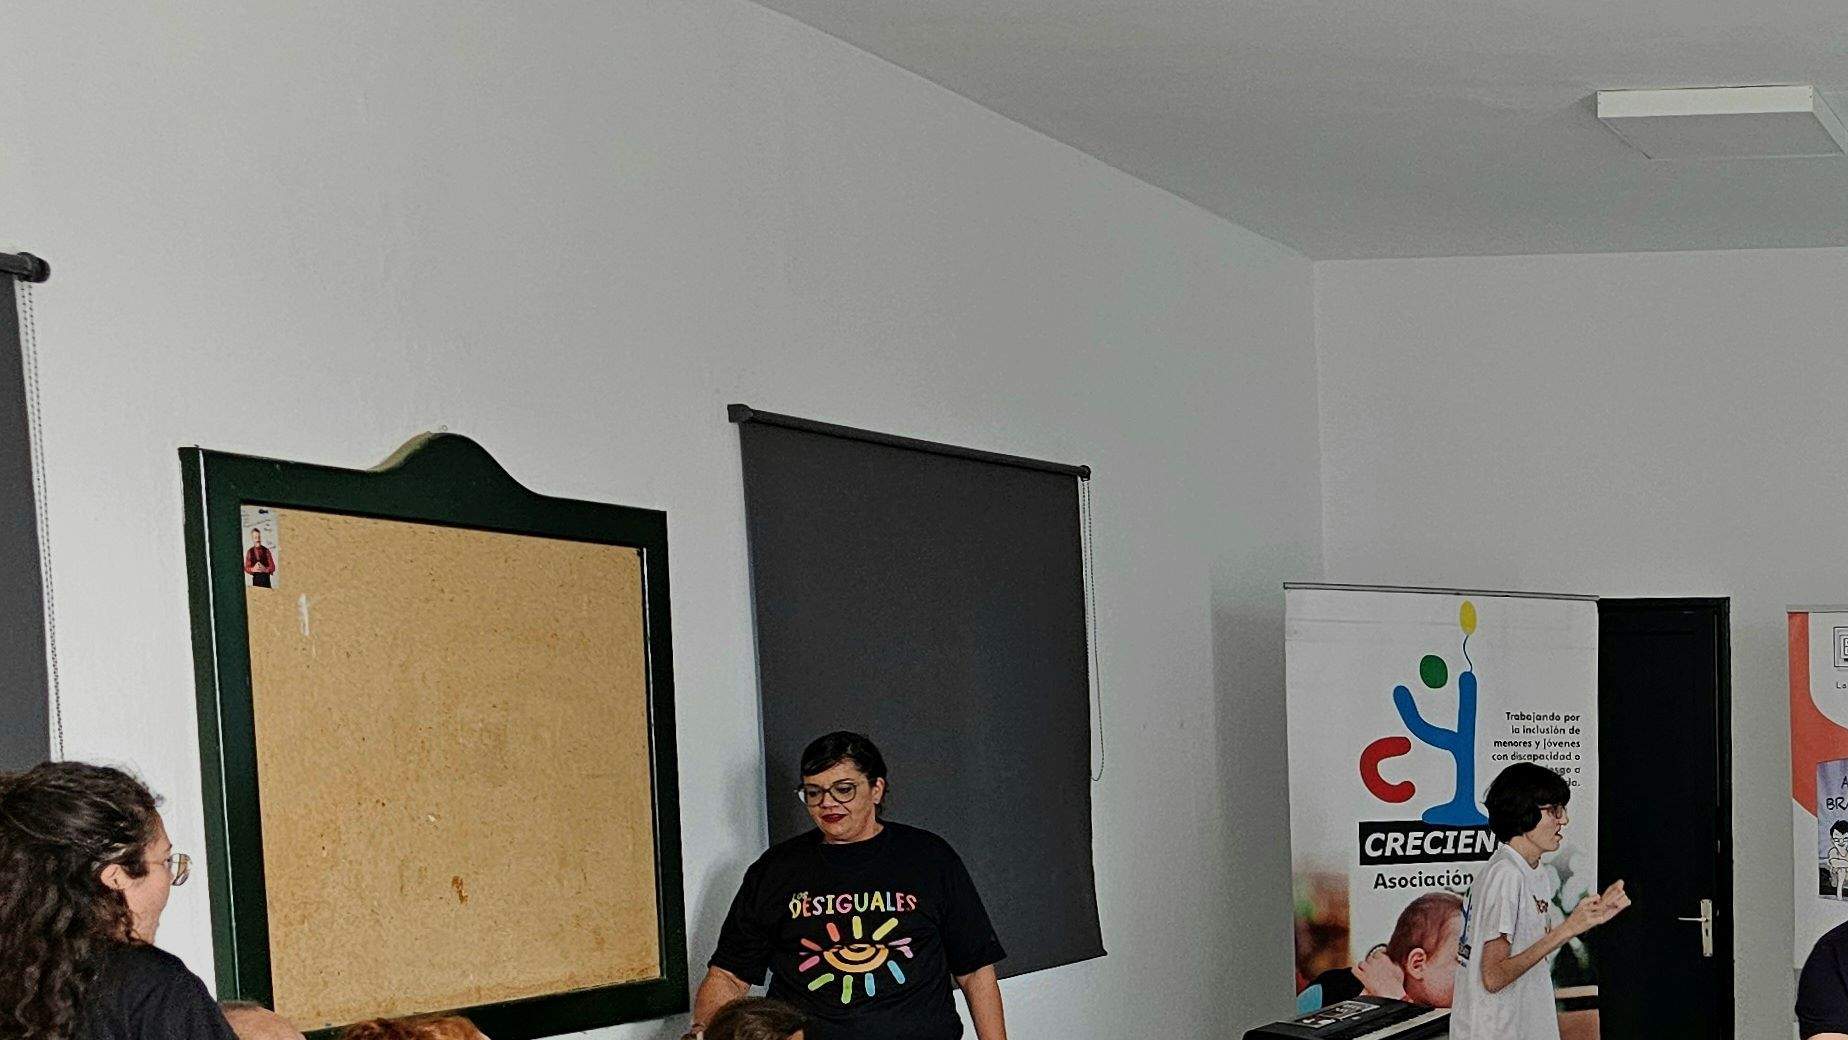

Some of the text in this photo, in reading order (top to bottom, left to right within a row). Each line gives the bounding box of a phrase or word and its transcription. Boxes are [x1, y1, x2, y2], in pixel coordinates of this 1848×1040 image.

[1836, 681, 1847, 690] La
[1505, 711, 1580, 723] Trabajando por
[1511, 725, 1580, 735] la inclusión de
[1494, 738, 1580, 749] menores y jóvenes
[1492, 753, 1508, 761] con
[1510, 751, 1571, 762] discapacidad
[1364, 830, 1496, 857] CRECIEN
[1373, 869, 1474, 889] Asociación
[789, 891, 917, 919] DESIGUALES
